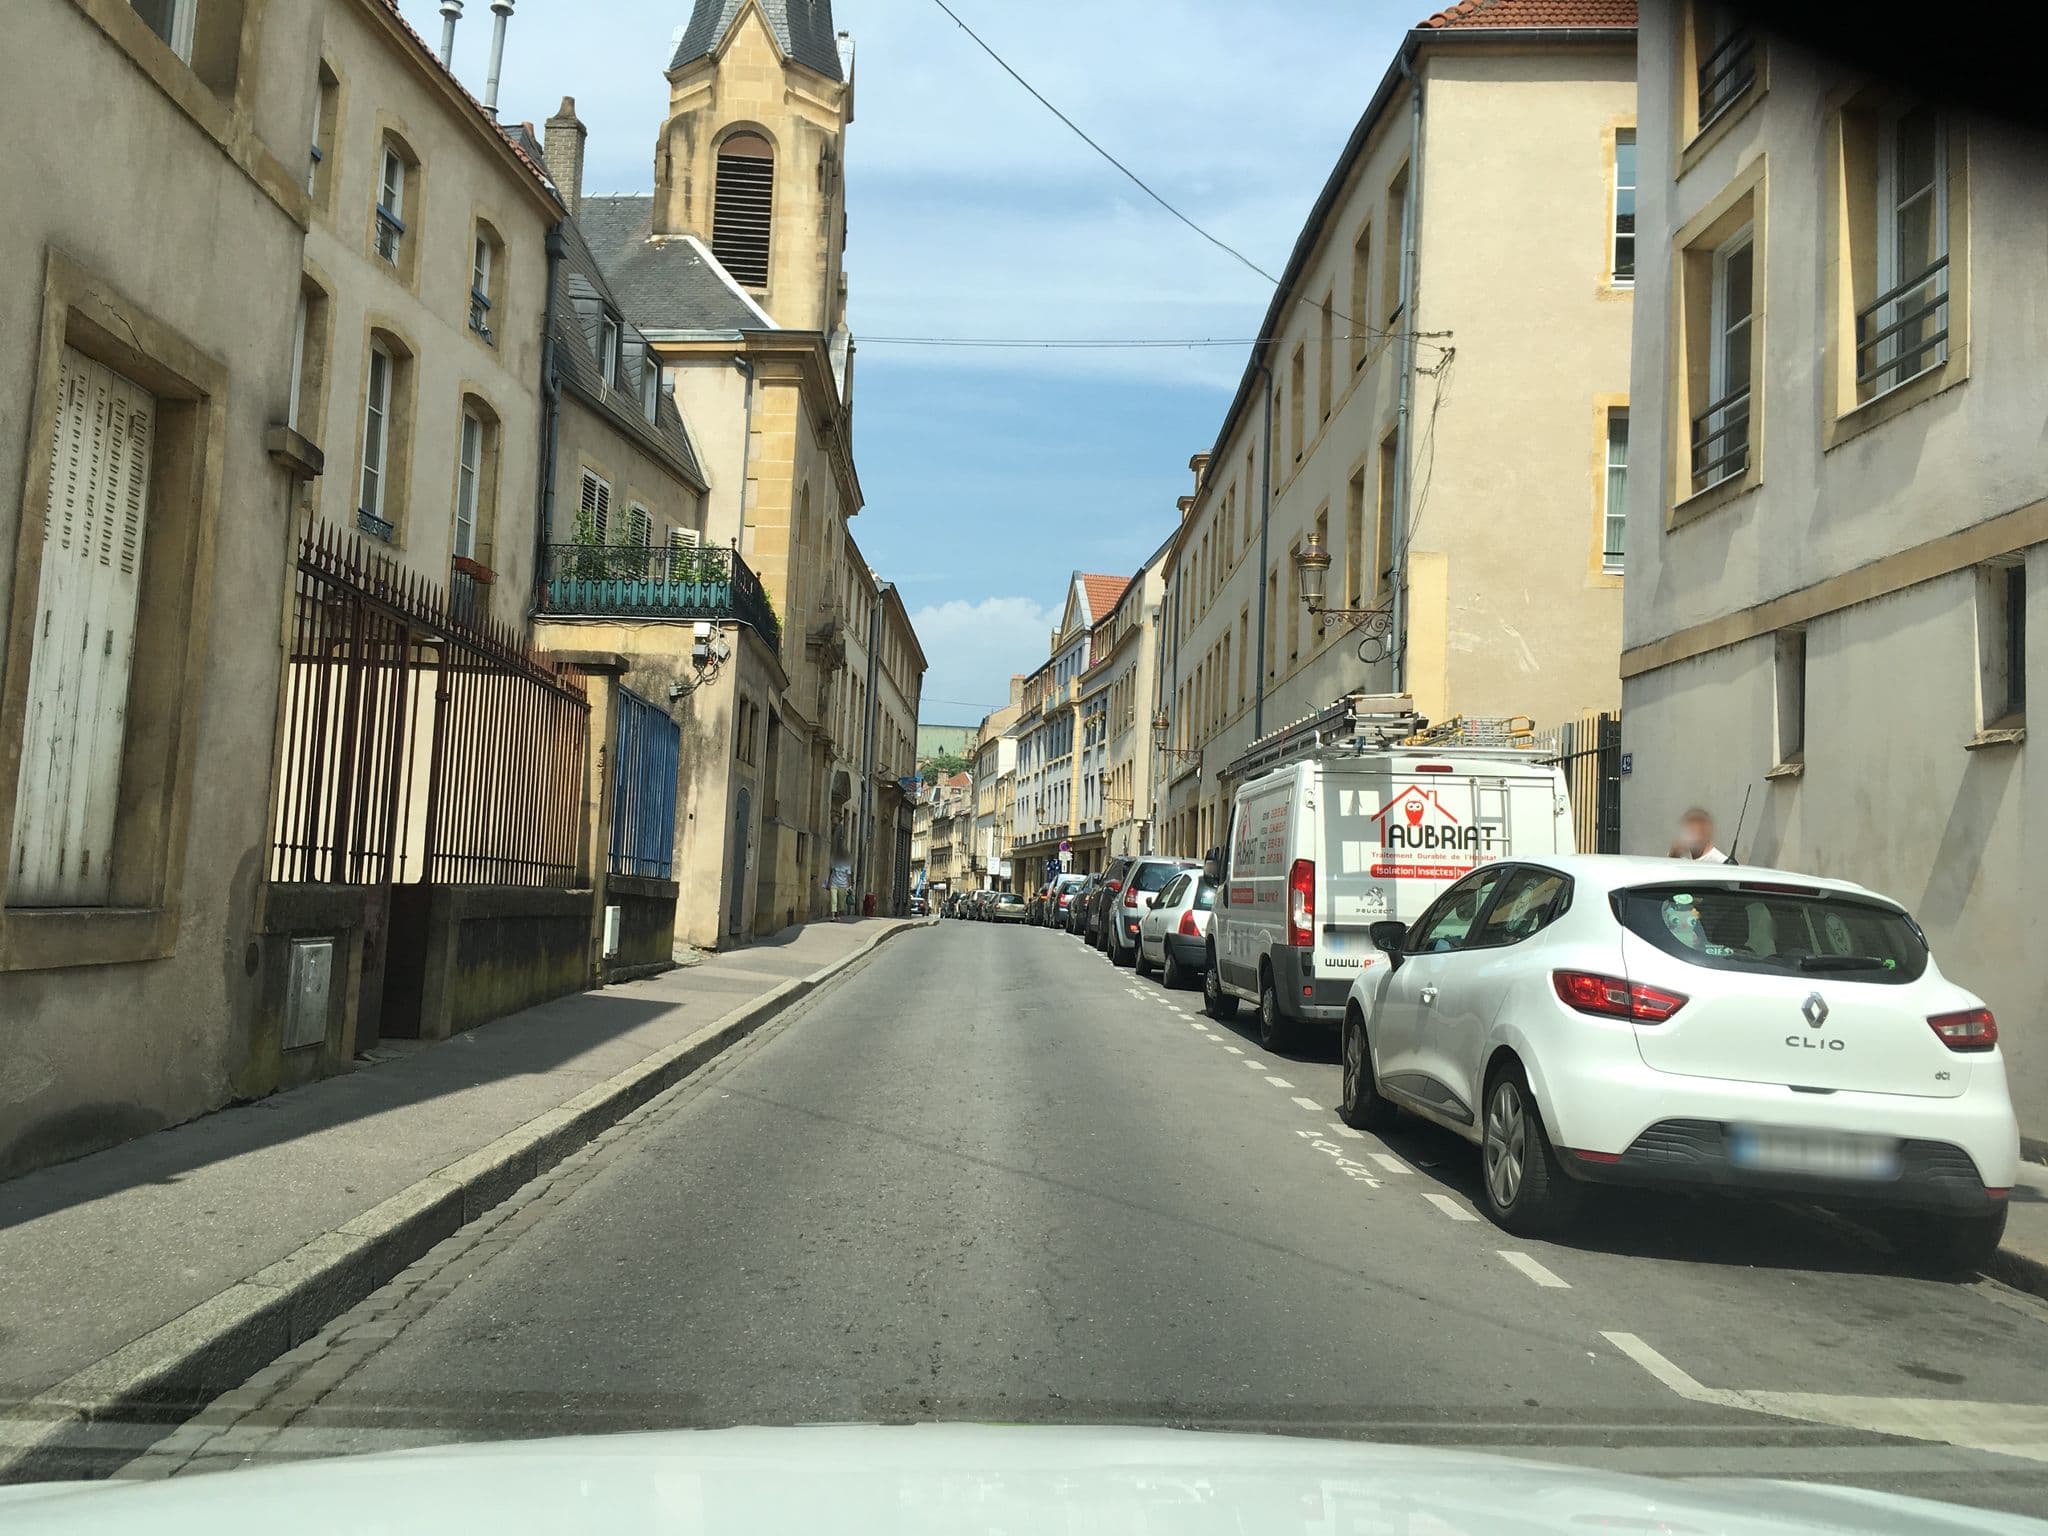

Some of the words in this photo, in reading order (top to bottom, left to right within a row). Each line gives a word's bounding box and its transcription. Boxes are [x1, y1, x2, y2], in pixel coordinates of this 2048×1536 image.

[1622, 756, 1631, 771] 42
[1388, 824, 1497, 850] AUBRIAT
[1371, 851, 1412, 859] Traitement
[1785, 1035, 1845, 1051] CLIO
